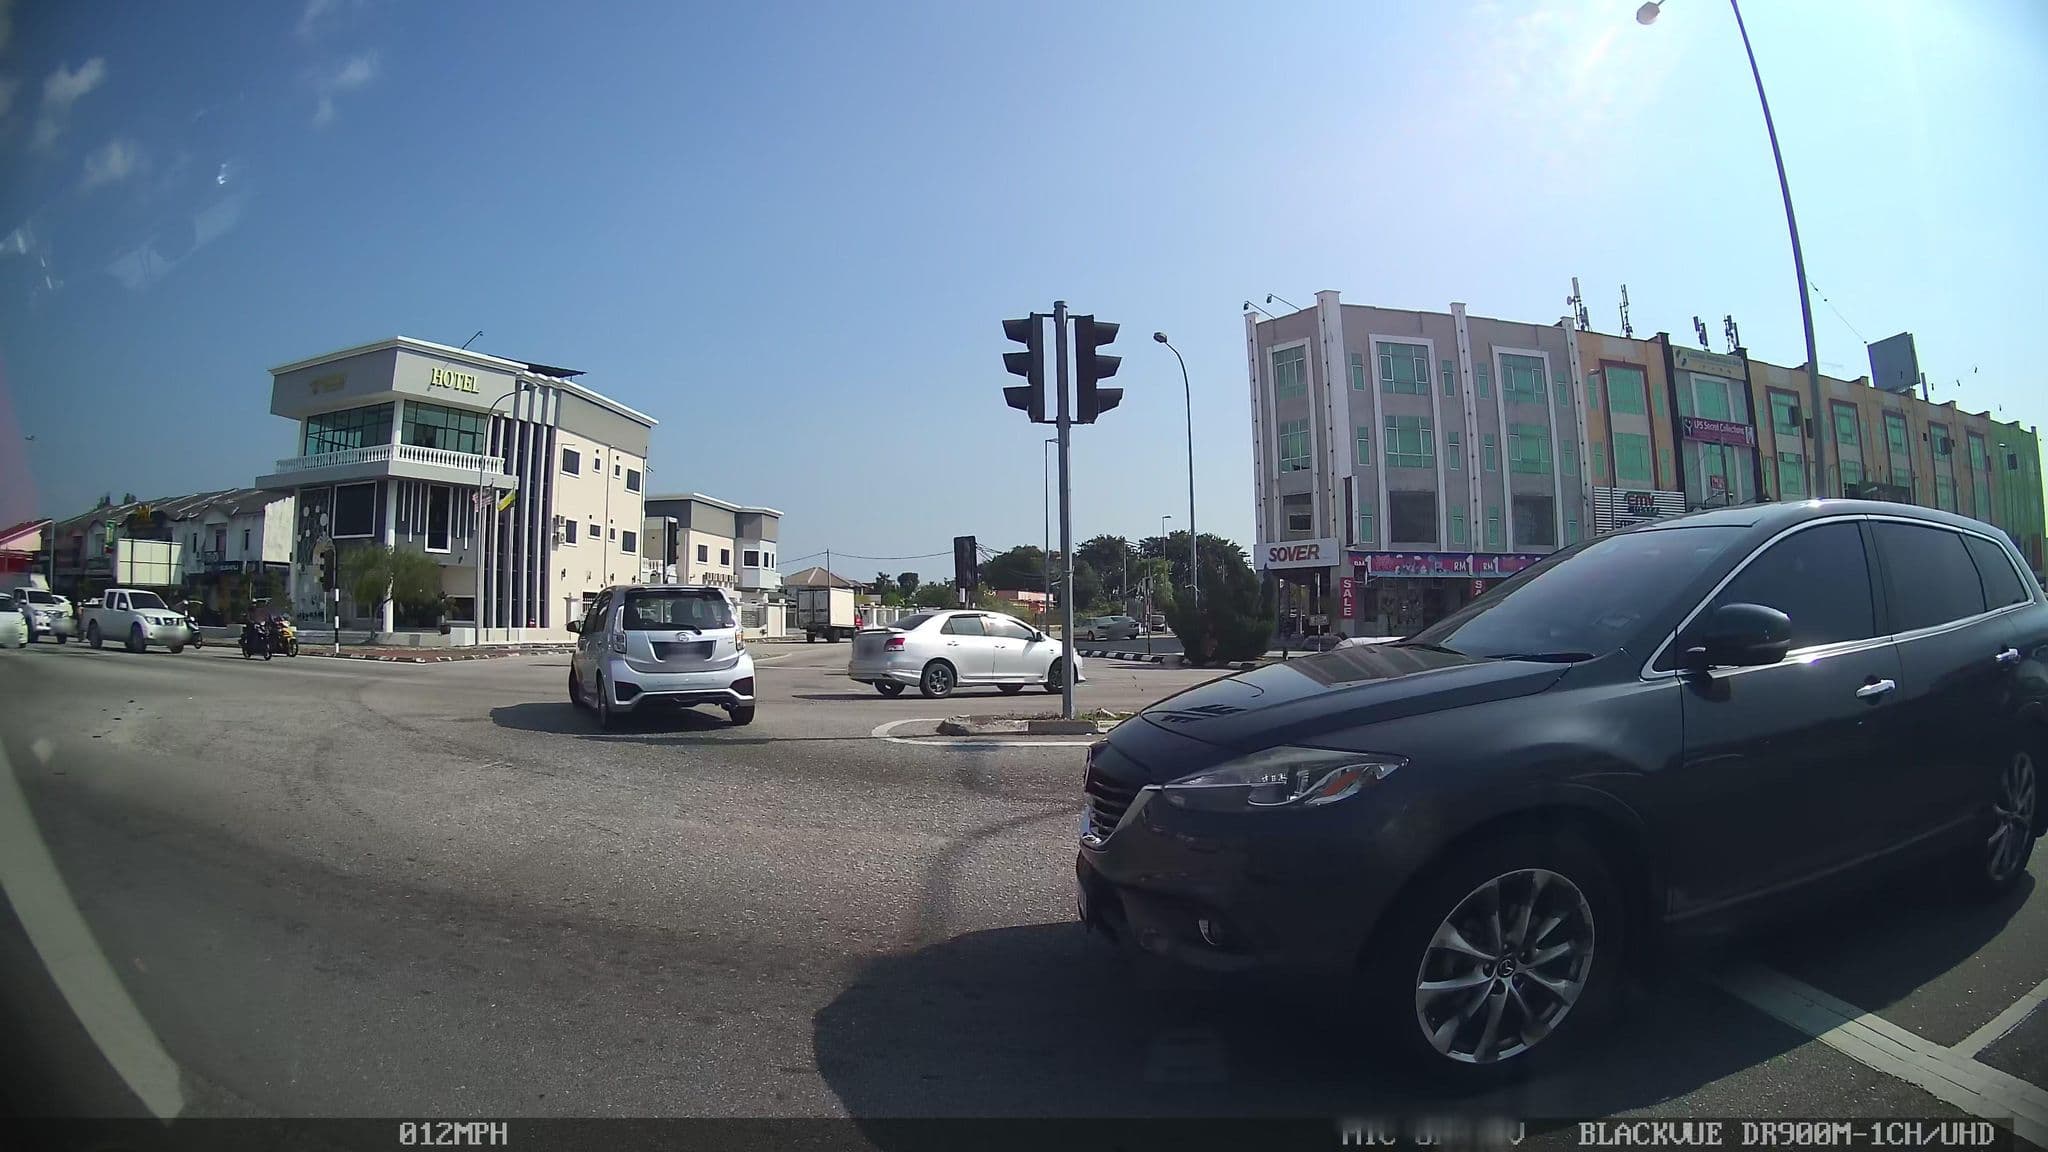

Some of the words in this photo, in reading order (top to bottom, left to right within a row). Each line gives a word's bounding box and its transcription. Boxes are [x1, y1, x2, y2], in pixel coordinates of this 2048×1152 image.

[431, 367, 480, 394] HOTEL
[1268, 544, 1320, 562] SOVER
[1343, 579, 1352, 616] SALE
